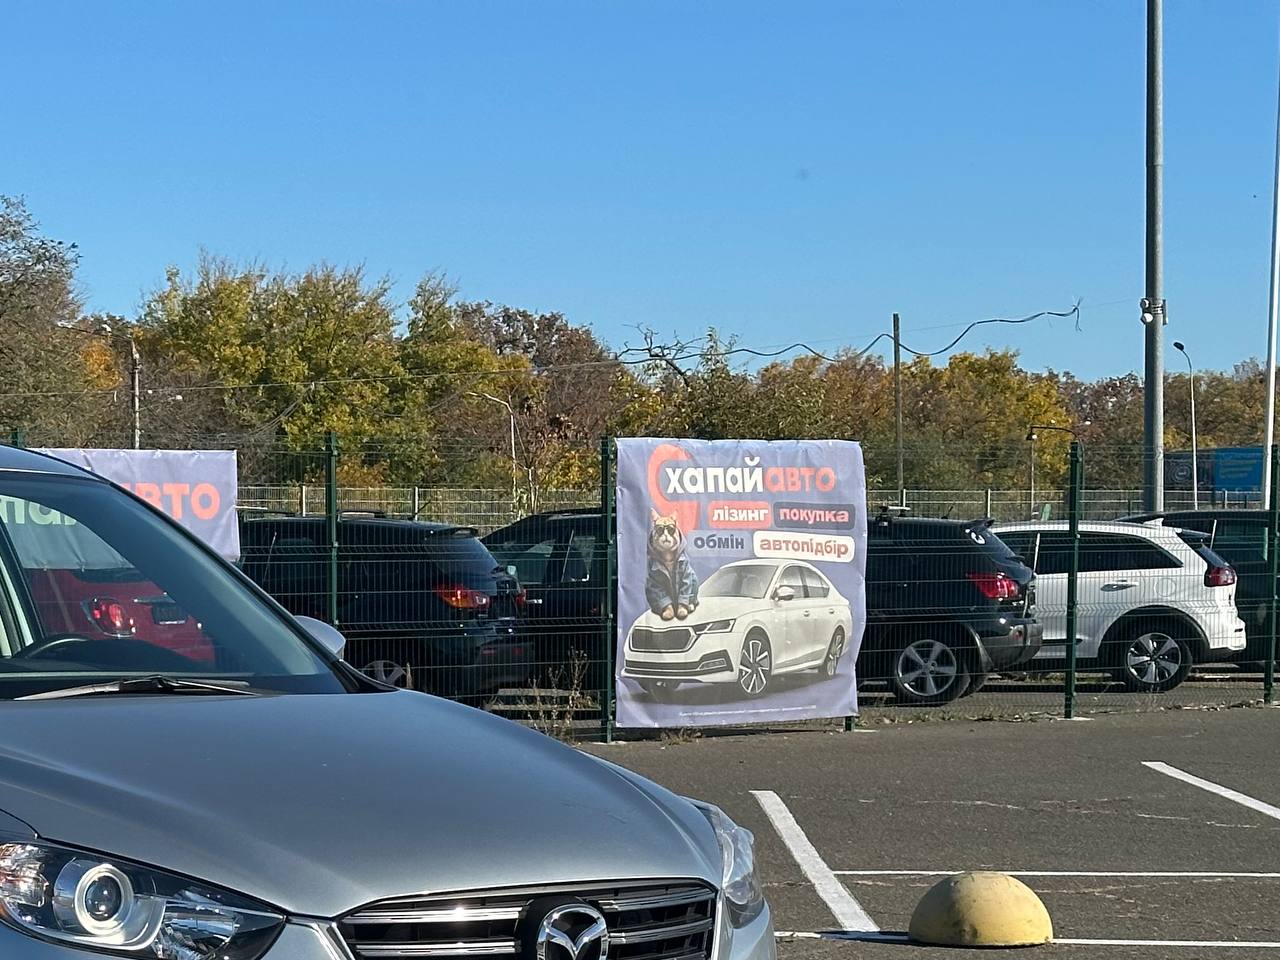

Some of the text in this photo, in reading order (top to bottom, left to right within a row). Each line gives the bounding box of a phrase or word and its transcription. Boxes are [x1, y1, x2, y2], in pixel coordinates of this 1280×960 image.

[712, 506, 849, 525] лізинг покупка
[694, 534, 848, 558] обмін автопідбір
